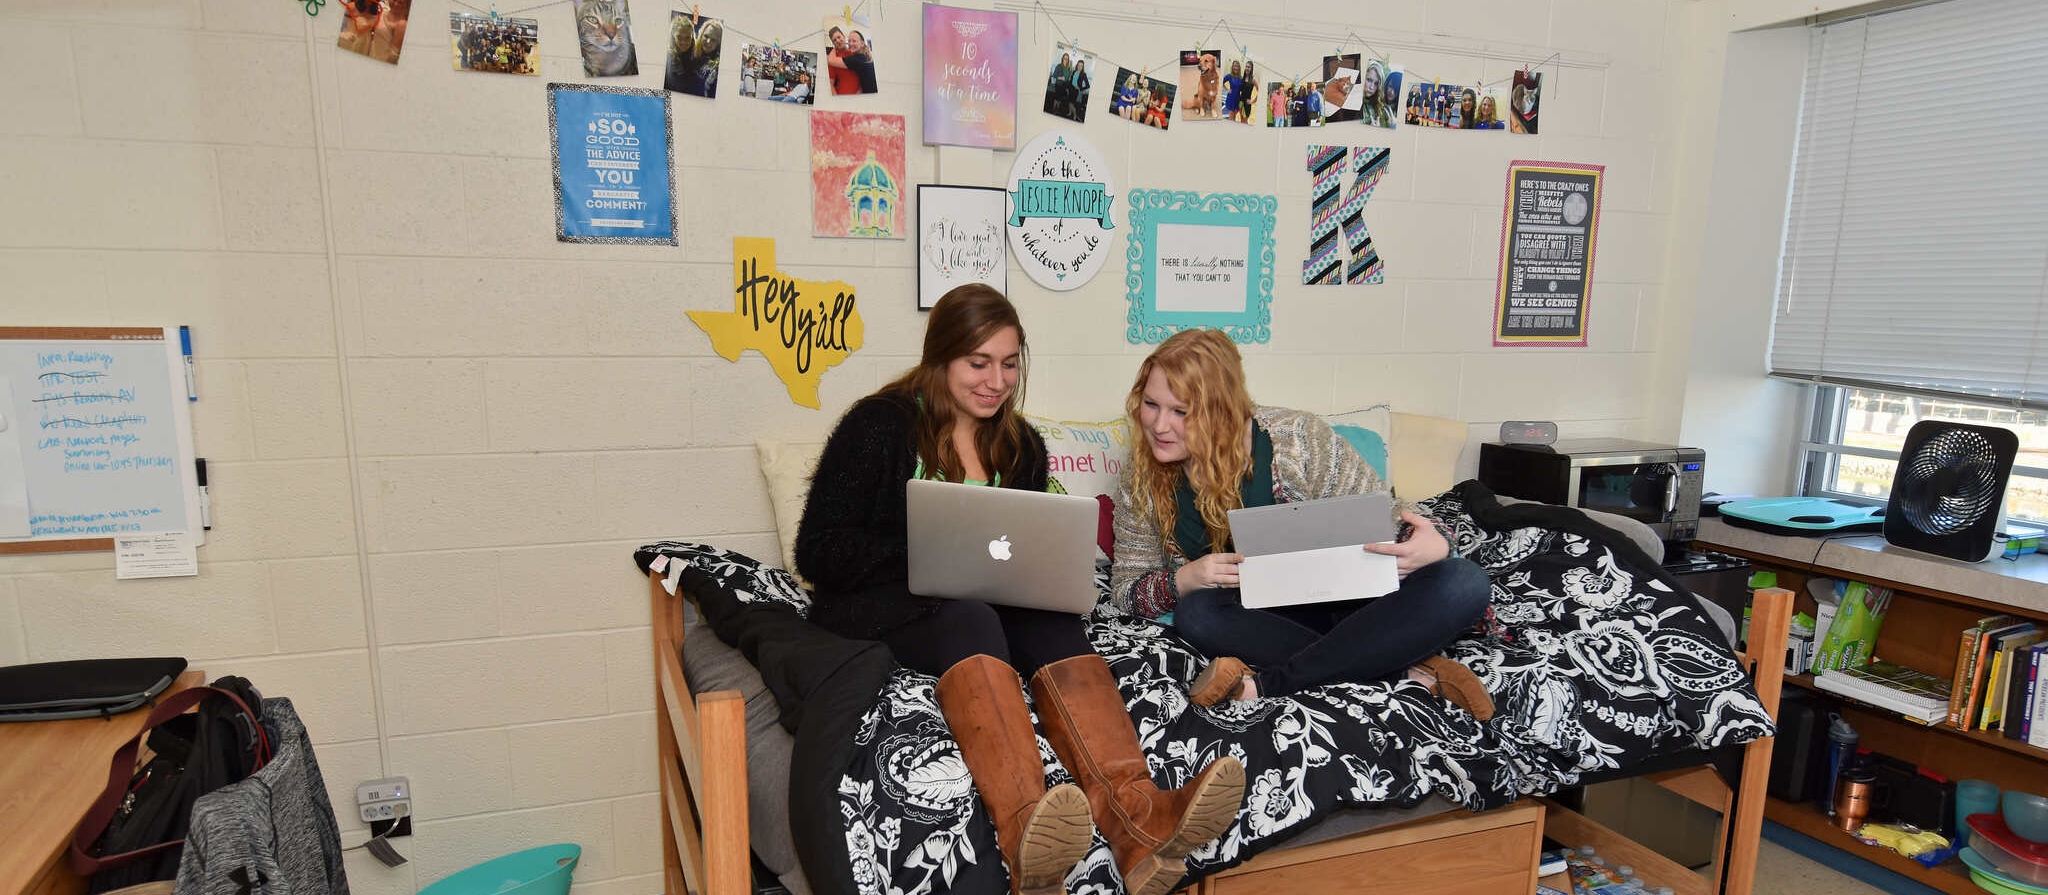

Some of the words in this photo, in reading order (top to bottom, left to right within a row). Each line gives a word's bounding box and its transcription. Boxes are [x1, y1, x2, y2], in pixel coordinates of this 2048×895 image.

[961, 40, 978, 61] 10
[943, 59, 994, 85] seconds
[936, 83, 954, 101] at
[969, 84, 1001, 101] time
[598, 118, 627, 136] SO
[586, 135, 640, 146] GOOD
[586, 149, 604, 159] THE
[606, 150, 641, 161] ADVICE
[594, 169, 634, 184] YOU
[1042, 160, 1056, 178] be
[1061, 160, 1081, 178] the
[1520, 180, 1539, 189] HERE'S
[1540, 181, 1547, 190] TO
[1548, 181, 1557, 190] THE
[1557, 182, 1574, 191] CRAZY
[1575, 183, 1589, 192] ONES
[586, 200, 647, 211] COMMENT?
[1021, 183, 1059, 214] LESLIE
[1063, 184, 1104, 215] KNOPE
[1538, 196, 1563, 208] Rebels
[1053, 216, 1064, 235] of
[1022, 232, 1067, 271] whatever
[1071, 251, 1090, 271] you
[1084, 235, 1099, 251] do
[1520, 239, 1550, 249] DISAGREE
[1551, 240, 1567, 250] WITH
[1161, 258, 1180, 267] THERE
[1182, 258, 1189, 267] IS
[1219, 259, 1244, 268] NOTHING
[1175, 273, 1190, 282] THAT
[1192, 274, 1204, 282] YOU
[1205, 274, 1221, 282] CAN'T
[1223, 274, 1231, 282] DO
[736, 256, 800, 349] Hey
[1511, 298, 1526, 307] WE
[1527, 299, 1544, 307] SEE
[1545, 299, 1578, 308] GENIUS
[797, 292, 856, 374] y'all
[1037, 425, 1065, 440] ee
[1065, 427, 1110, 450] hug
[1048, 453, 1097, 473] anet
